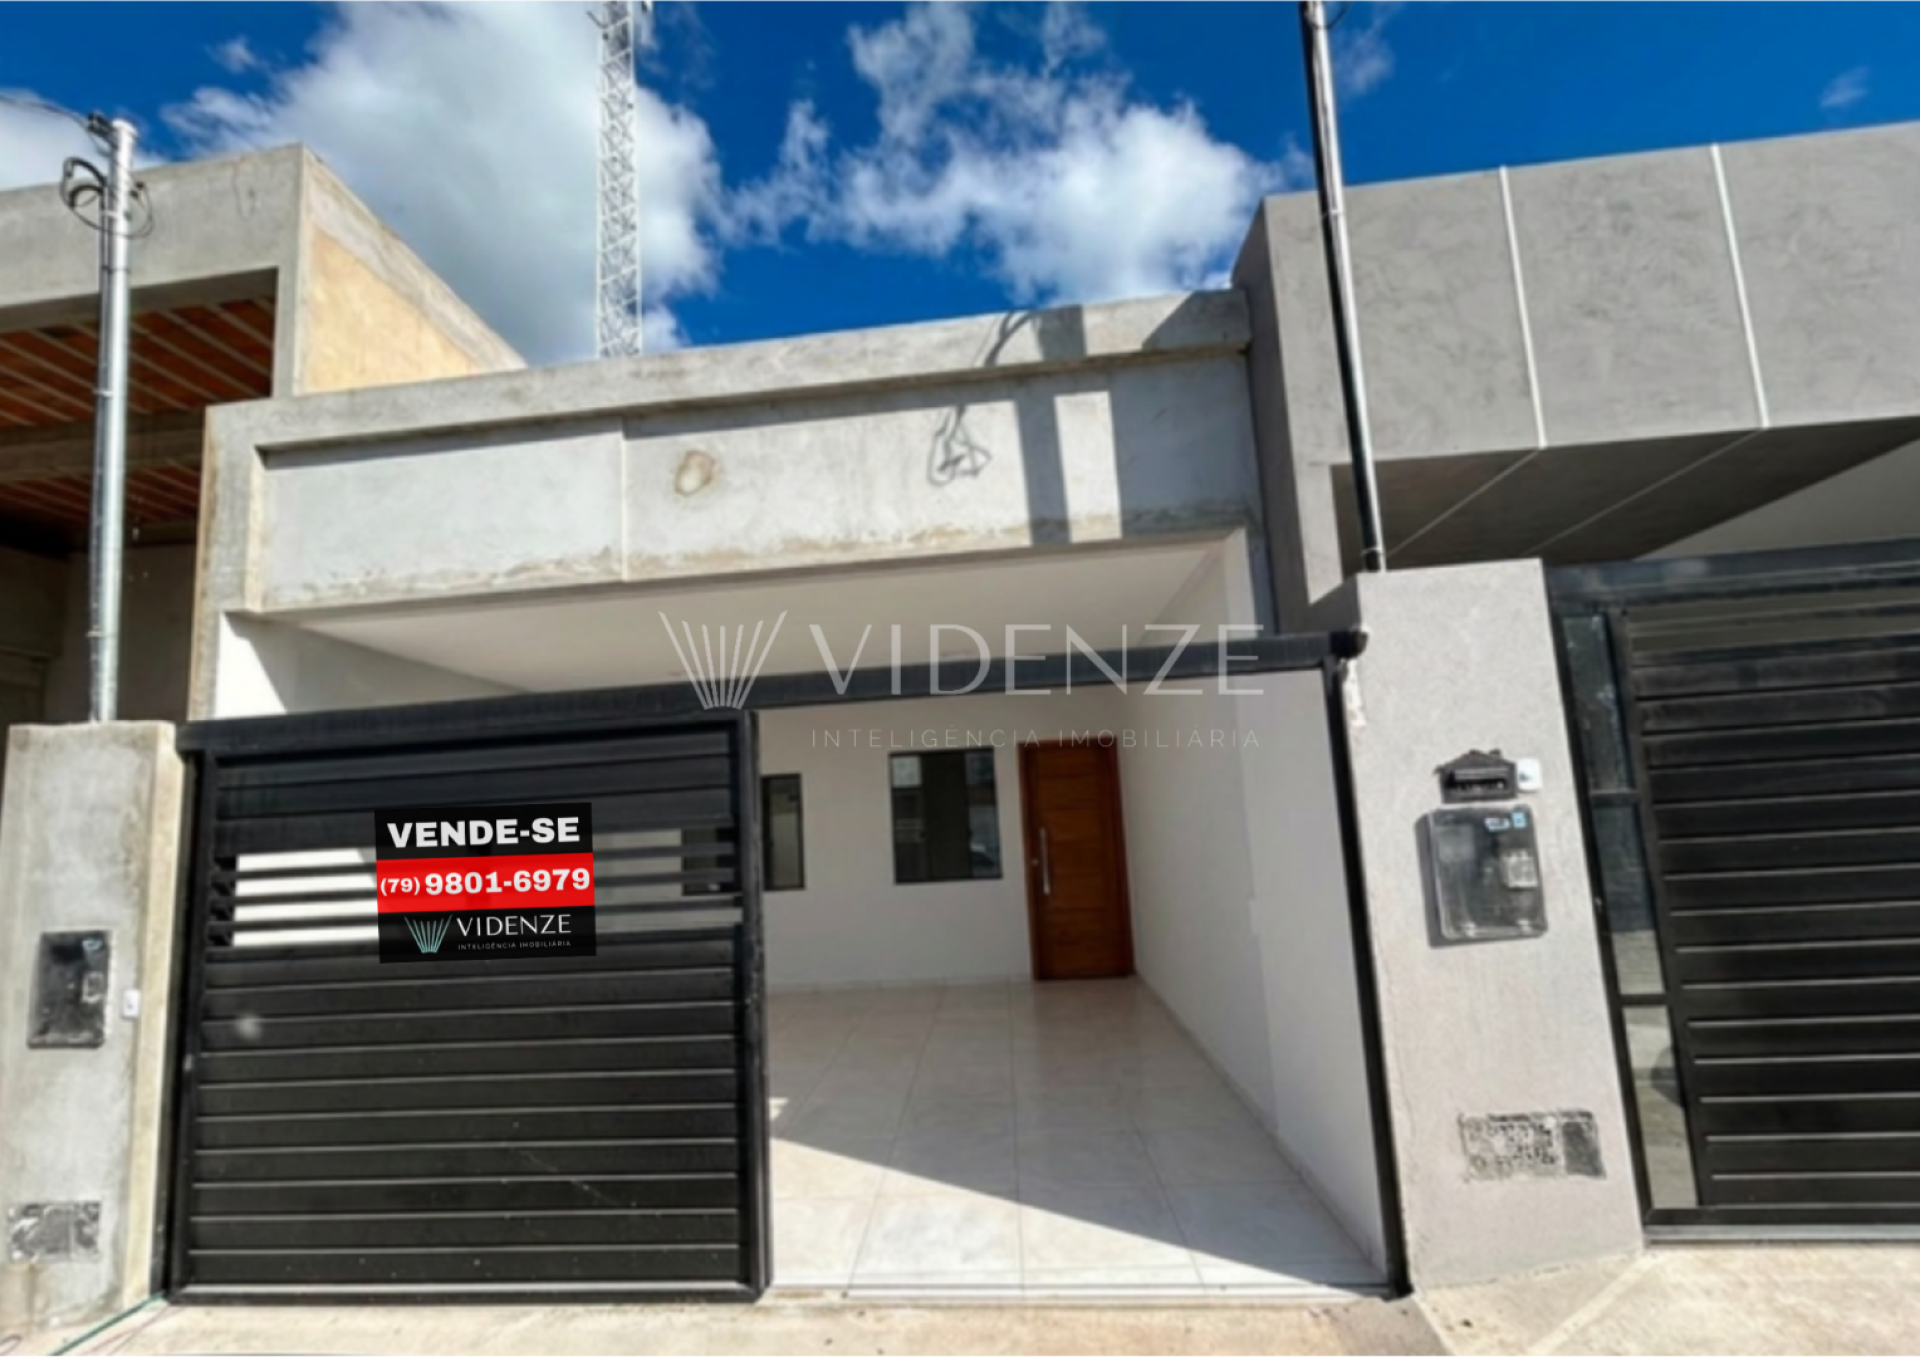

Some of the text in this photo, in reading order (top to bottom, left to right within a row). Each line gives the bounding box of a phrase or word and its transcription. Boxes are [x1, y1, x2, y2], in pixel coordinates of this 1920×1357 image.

[387, 816, 580, 848] VENDE-SE
[380, 867, 590, 897] (79) 9801-6979
[456, 914, 572, 937] VIDENZE
